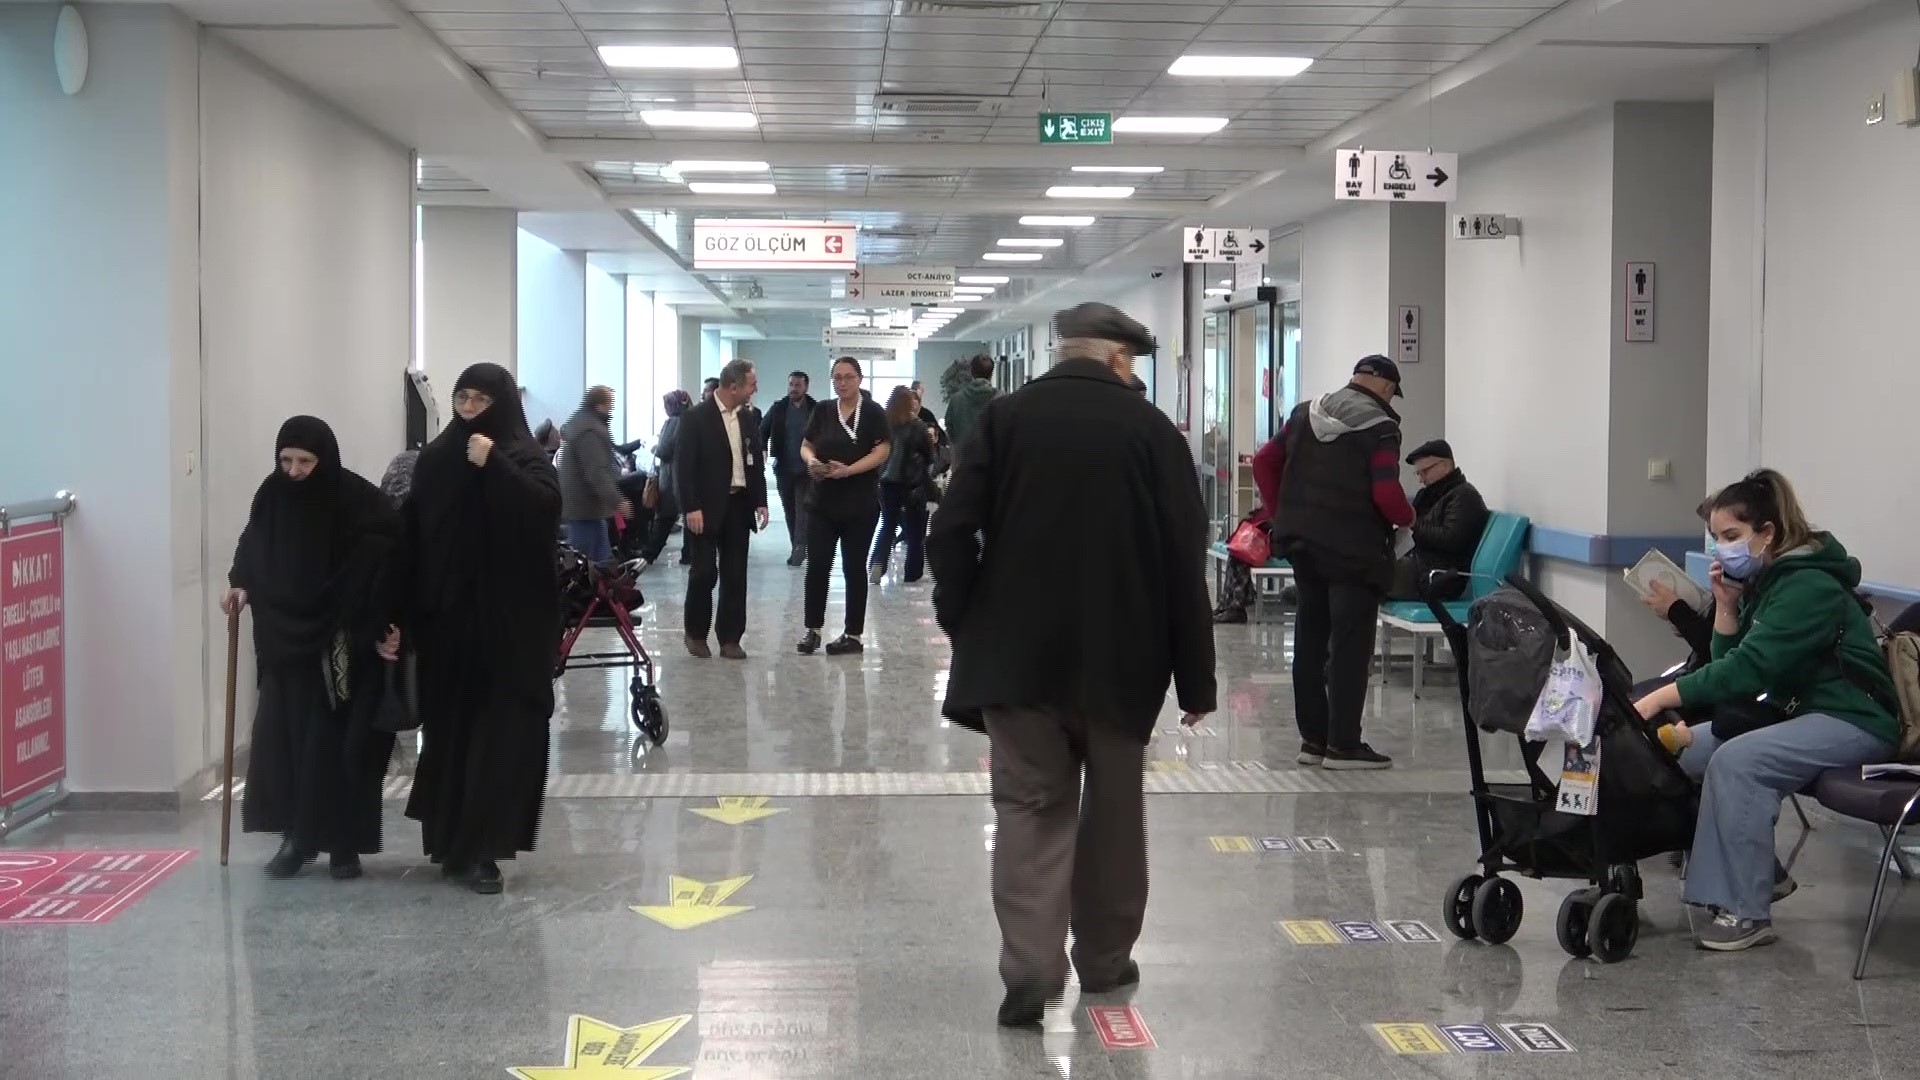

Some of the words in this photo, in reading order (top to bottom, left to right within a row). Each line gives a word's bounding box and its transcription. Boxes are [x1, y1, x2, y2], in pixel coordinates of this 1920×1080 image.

[1080, 128, 1105, 137] EXIT
[705, 232, 740, 251] GÖZ
[744, 232, 806, 255] ÖLÇÜM
[911, 289, 951, 298] BİYOMETRİ
[12, 552, 52, 588] DİKKAT!
